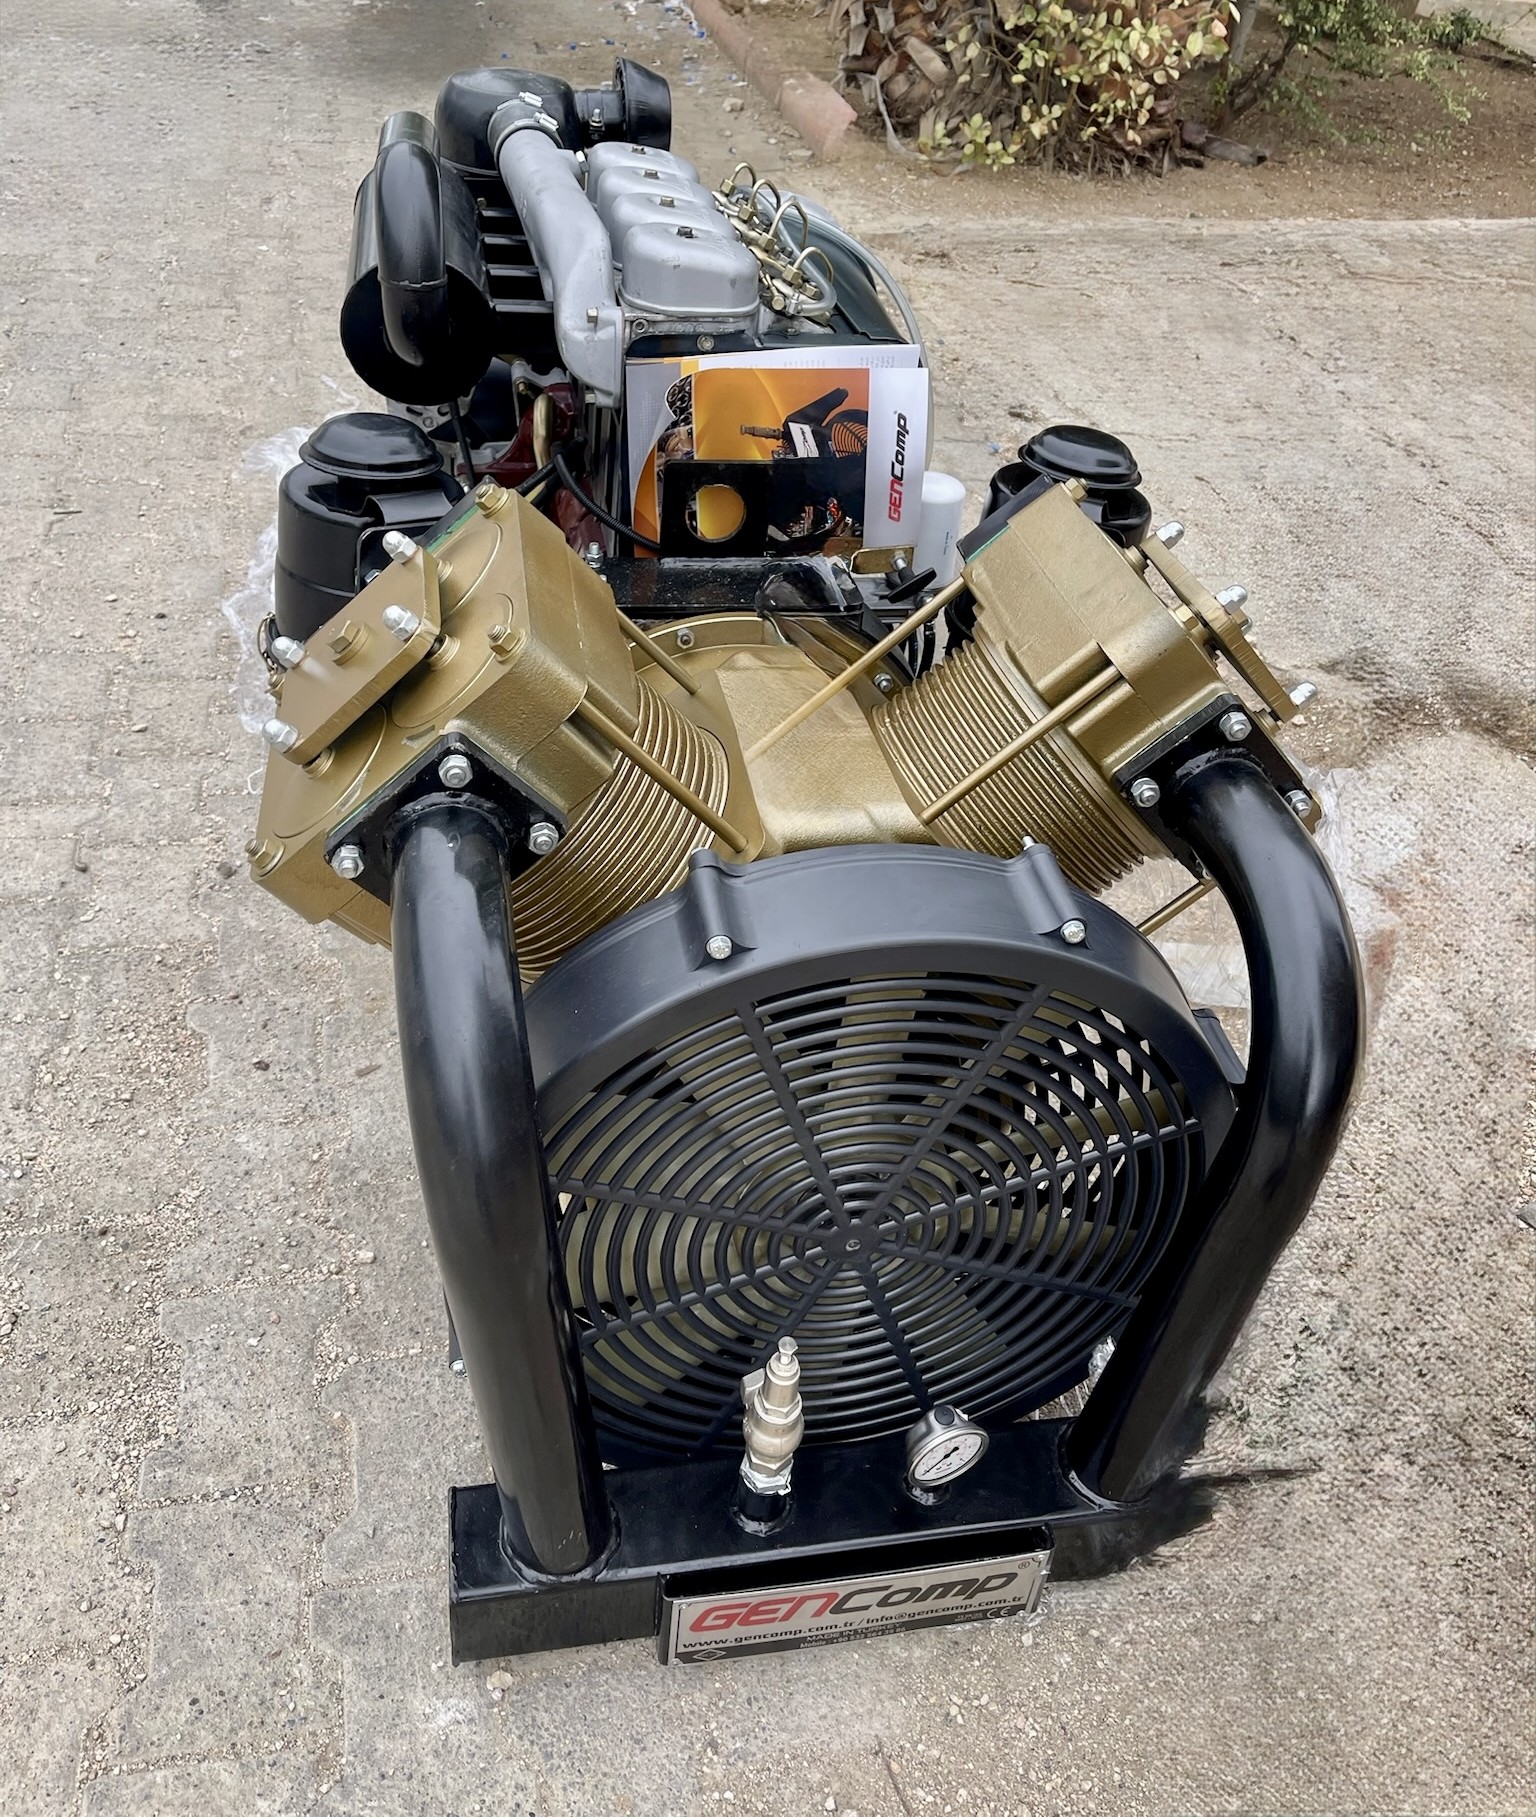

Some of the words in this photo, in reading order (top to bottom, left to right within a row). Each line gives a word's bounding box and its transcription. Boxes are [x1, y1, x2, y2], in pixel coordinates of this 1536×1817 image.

[682, 1621, 856, 1649] www.gencomp.com.tr
[866, 1596, 1024, 1625] info@gencomp.com.tr
[806, 1633, 841, 1642] MADE
[857, 1623, 903, 1634] TURKEY
